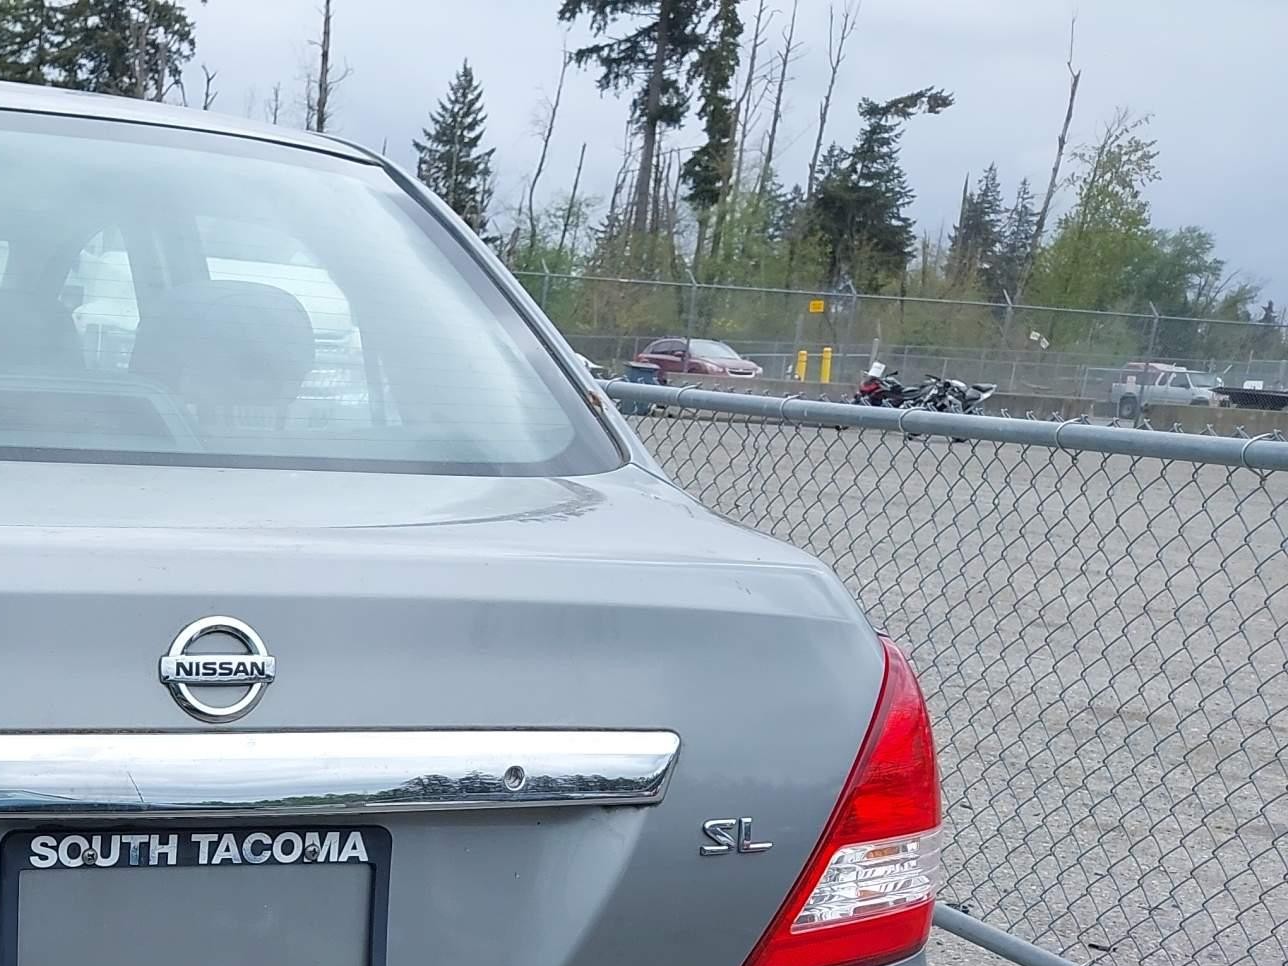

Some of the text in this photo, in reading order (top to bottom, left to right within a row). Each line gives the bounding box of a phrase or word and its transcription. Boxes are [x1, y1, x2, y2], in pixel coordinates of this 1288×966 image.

[175, 661, 266, 677] NISSAN
[29, 831, 369, 868] SOUTH TACOMA
[700, 817, 775, 856] SL
